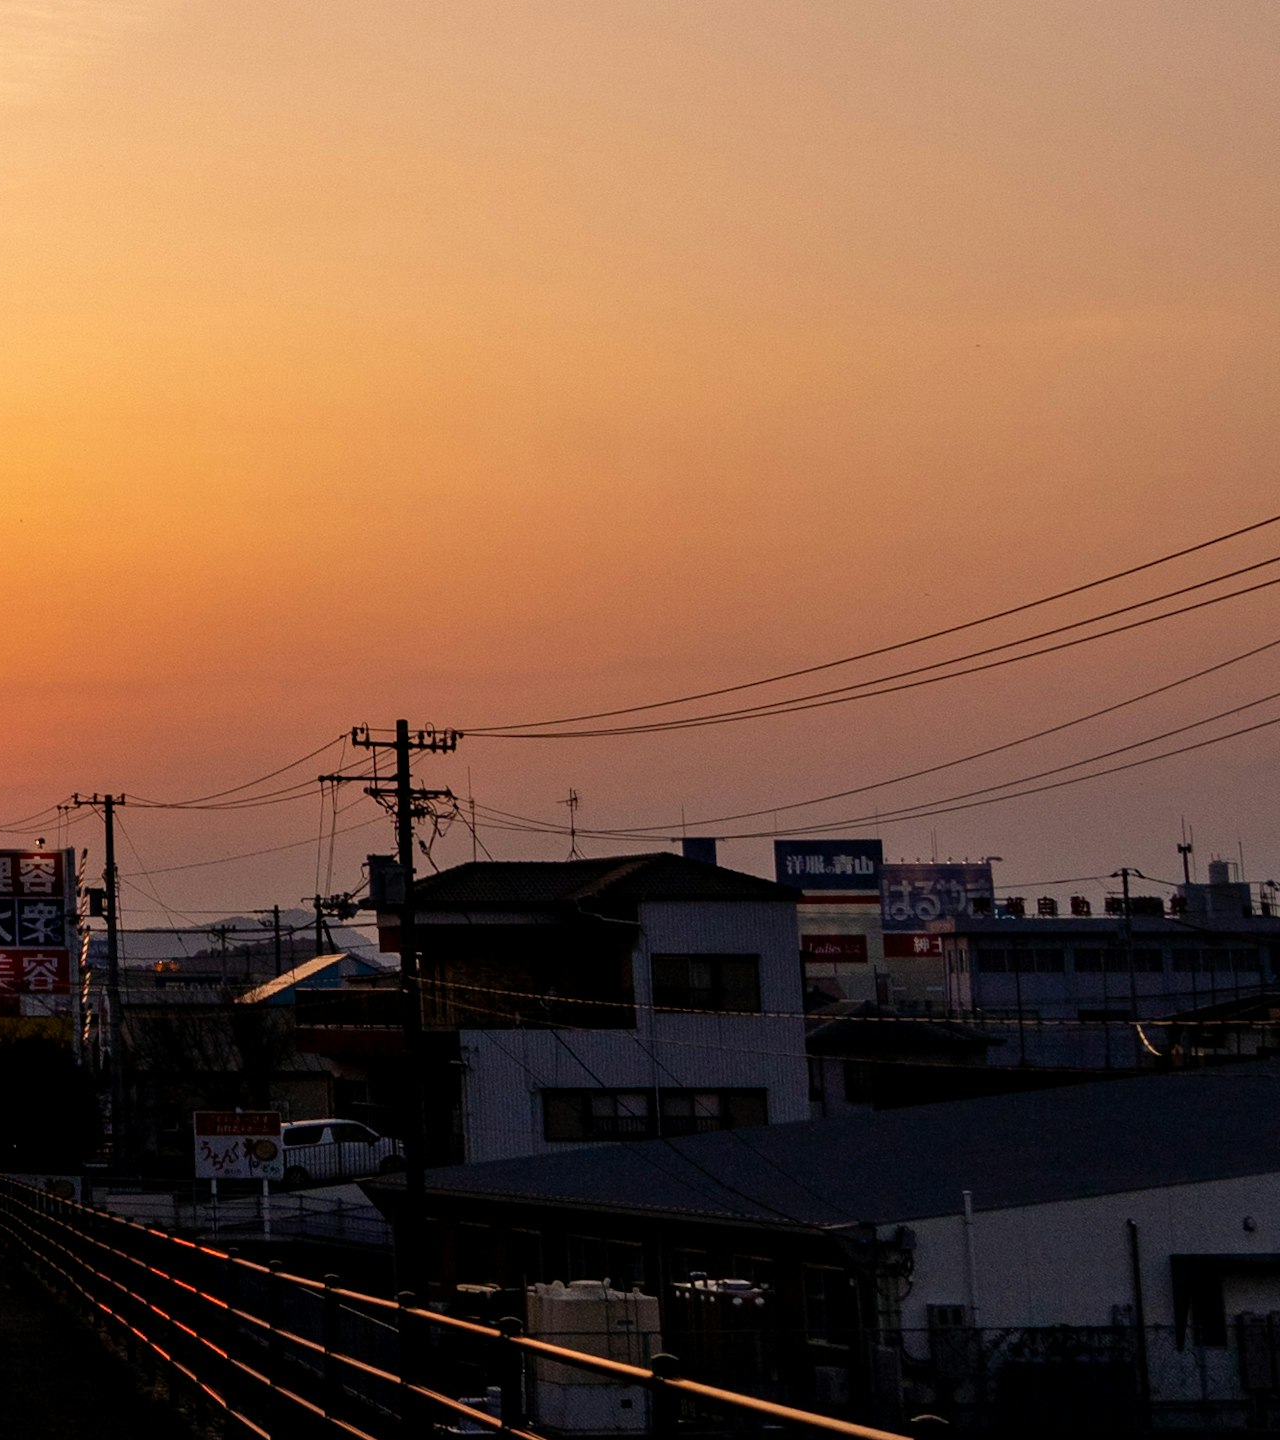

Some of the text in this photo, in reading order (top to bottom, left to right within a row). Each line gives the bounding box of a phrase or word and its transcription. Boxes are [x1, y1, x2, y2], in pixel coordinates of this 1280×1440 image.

[786, 854, 874, 875] 洋服の青山
